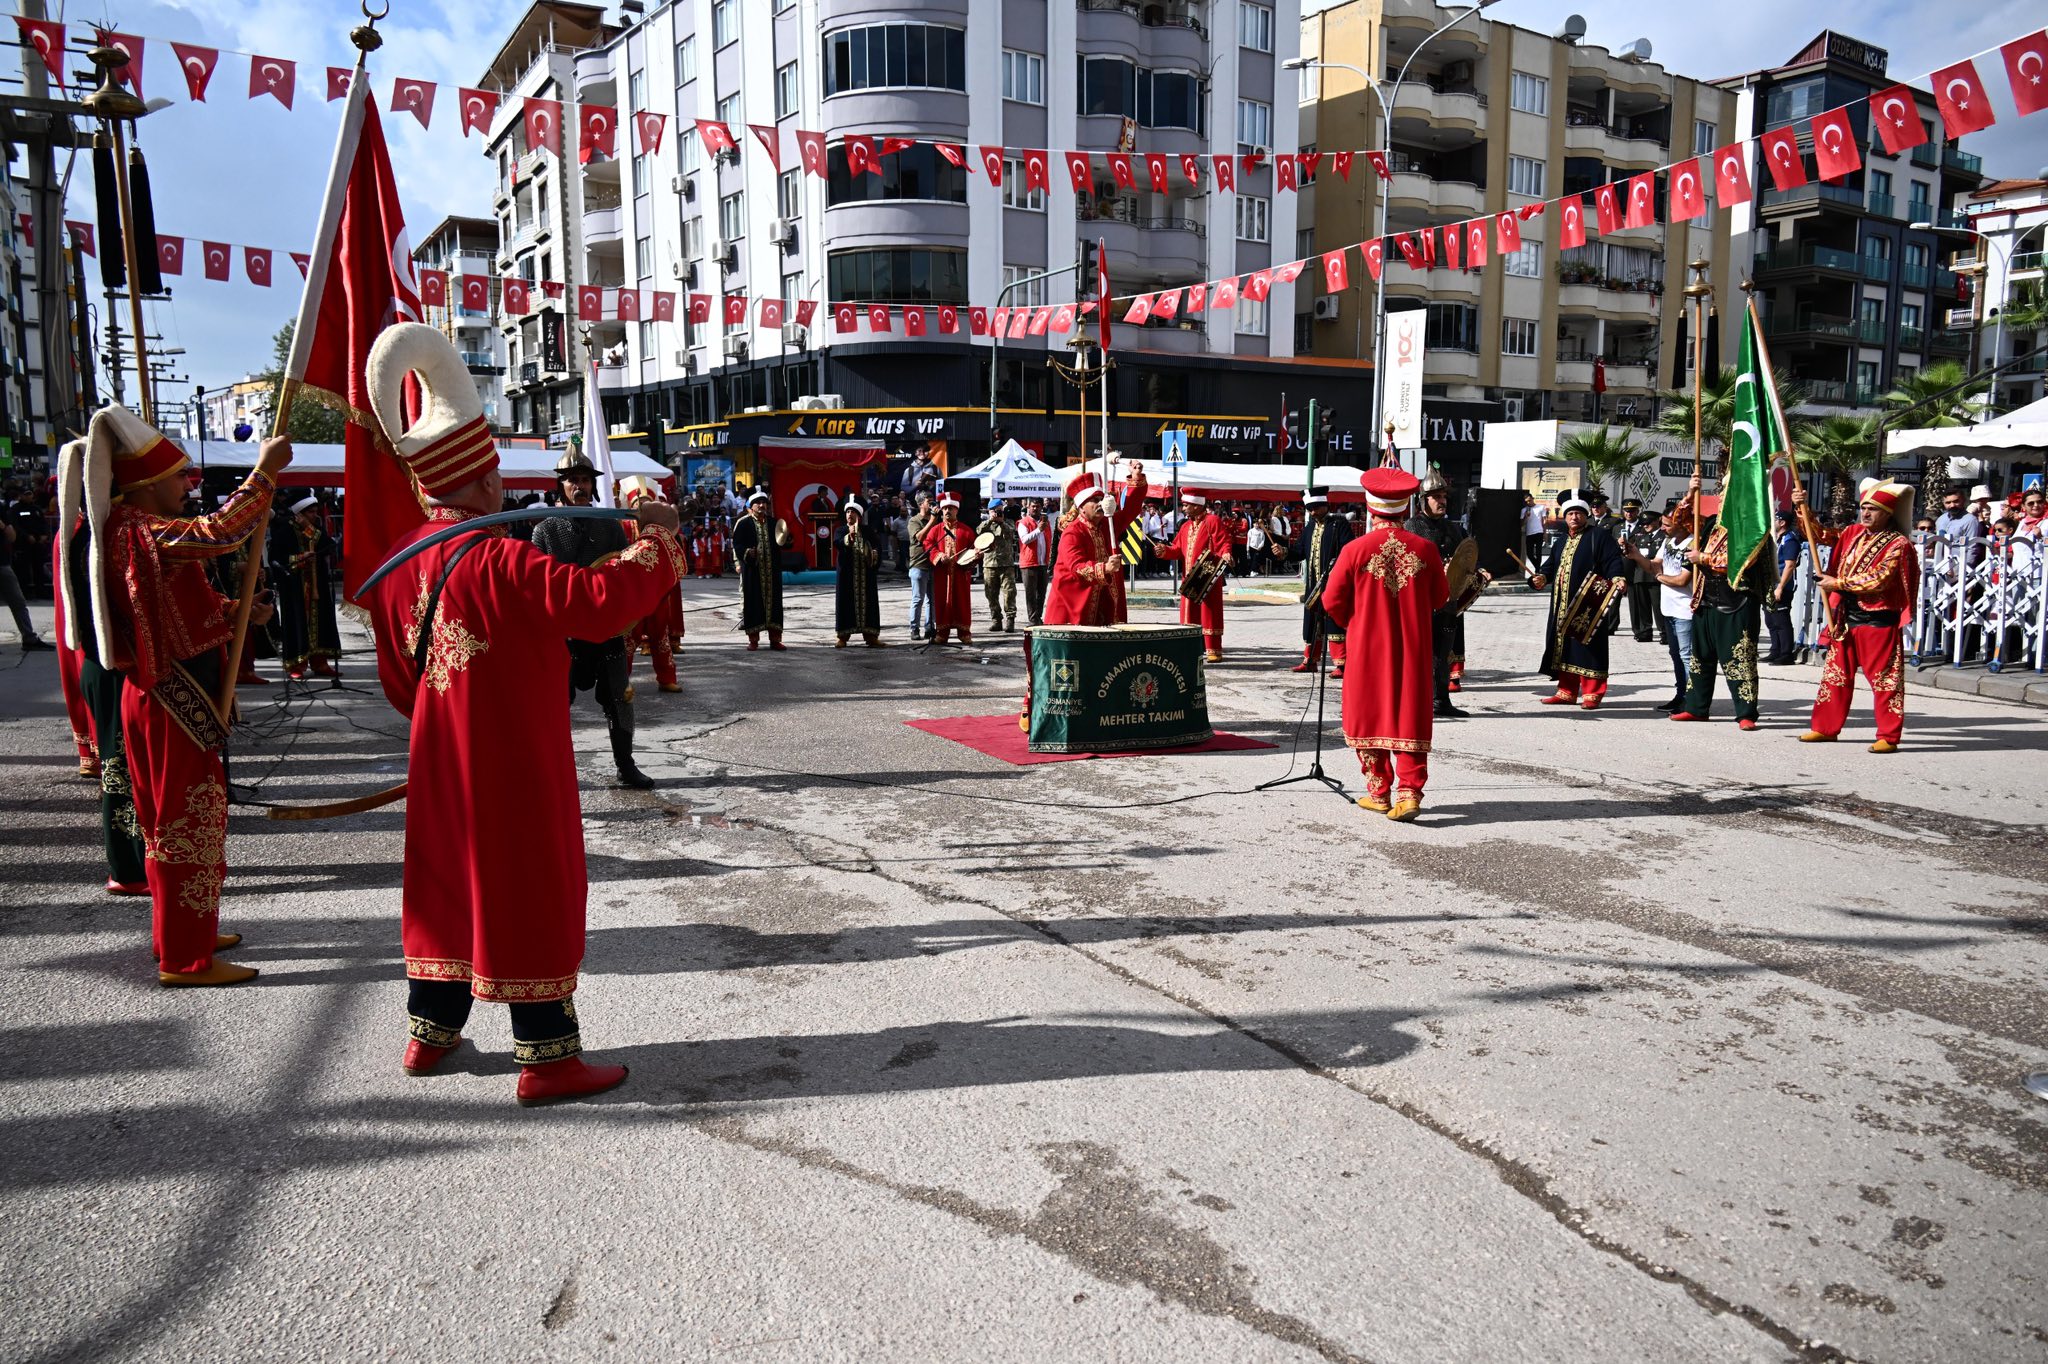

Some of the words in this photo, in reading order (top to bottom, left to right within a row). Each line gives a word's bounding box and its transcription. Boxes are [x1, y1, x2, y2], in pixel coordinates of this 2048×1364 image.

[815, 418, 856, 435] Kare
[866, 417, 906, 434] Kurs
[1209, 424, 1238, 439] Kurs
[698, 432, 714, 447] Kare
[717, 431, 730, 445] Kur
[1265, 430, 1353, 450] TOUHÉ
[1667, 460, 1703, 477] SAHN
[1098, 654, 1142, 698] OSMANİYE
[1099, 713, 1146, 727] MEHTER
[1148, 709, 1185, 723] TAKIMI
